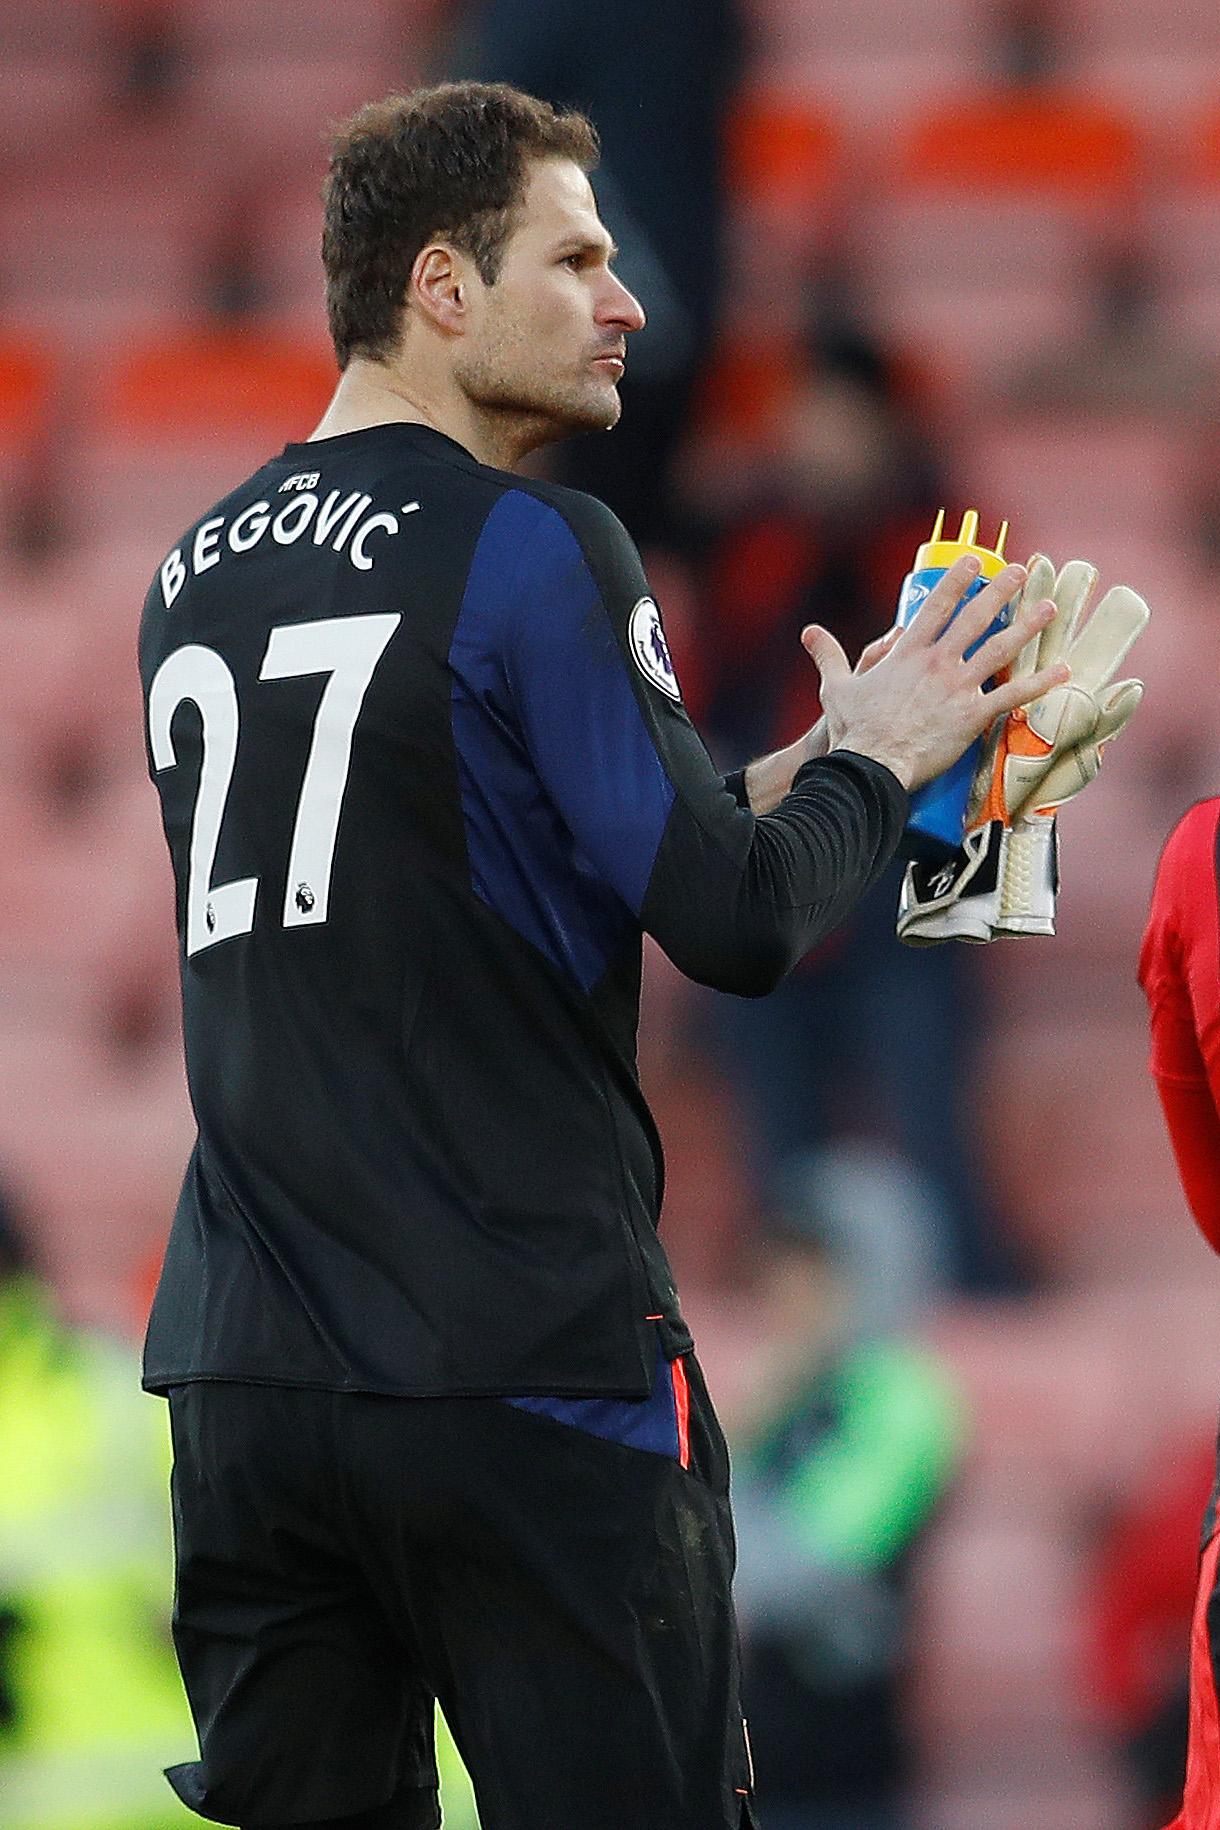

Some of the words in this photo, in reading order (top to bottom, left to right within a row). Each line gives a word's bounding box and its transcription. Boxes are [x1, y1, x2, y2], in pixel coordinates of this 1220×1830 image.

[278, 472, 320, 493] AFCB
[160, 490, 420, 609] BEGOVIĆ
[149, 612, 402, 957] 27
